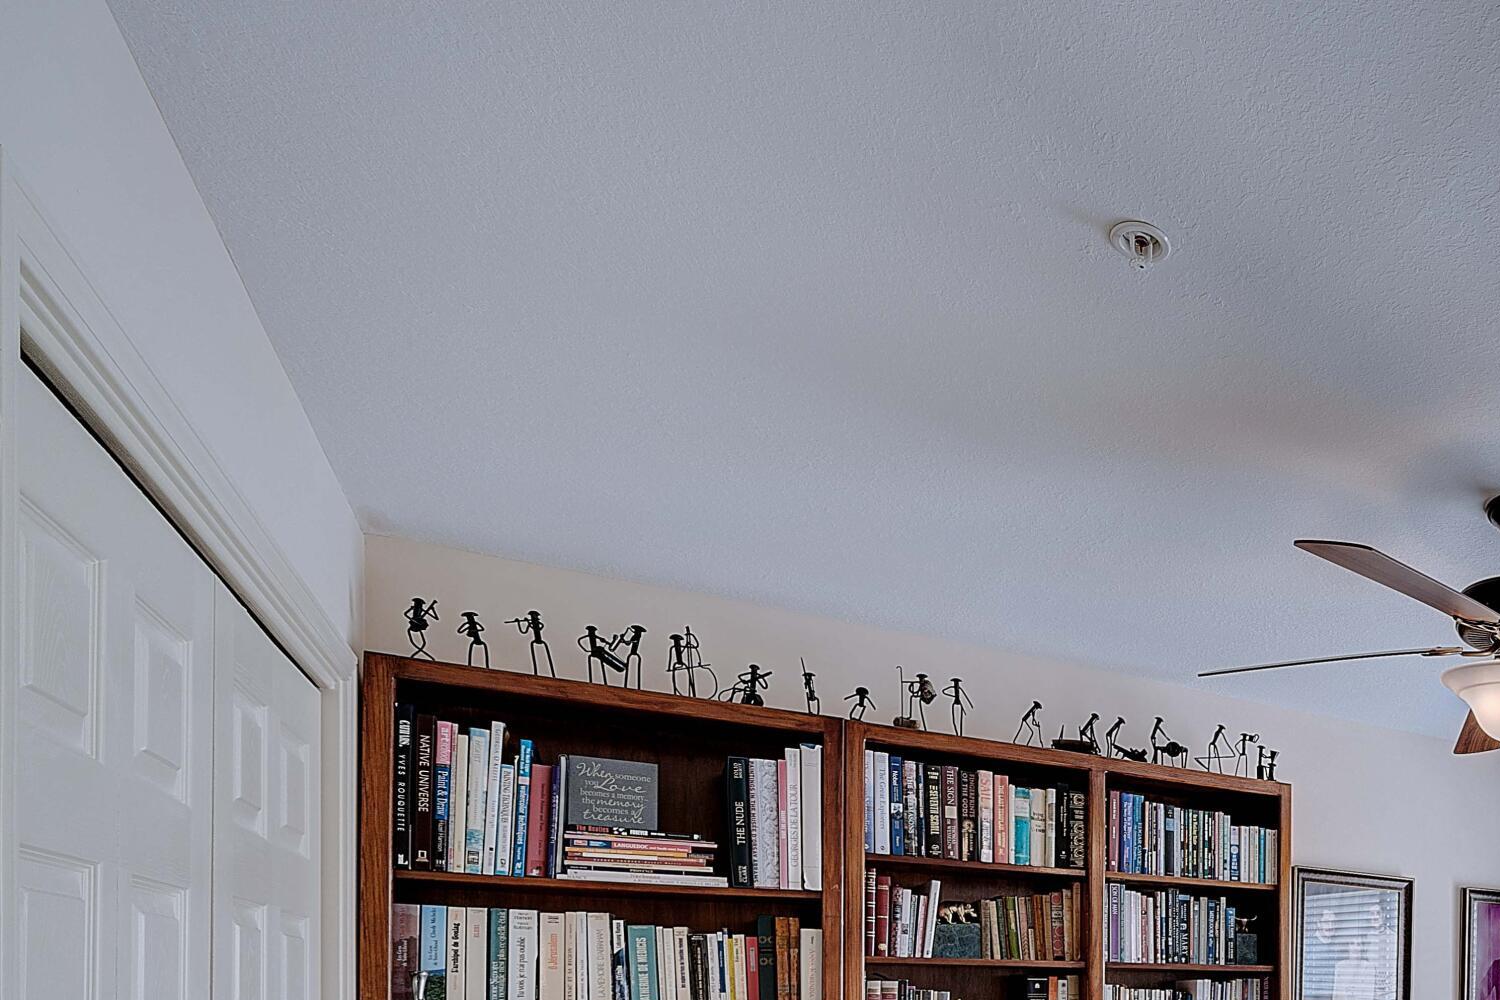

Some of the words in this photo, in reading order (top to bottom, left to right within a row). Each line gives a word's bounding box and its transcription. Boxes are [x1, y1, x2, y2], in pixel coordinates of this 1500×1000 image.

[418, 734, 430, 766] NATIVE
[437, 770, 449, 788] Paint
[576, 762, 613, 779] When
[615, 774, 651, 783] someone
[946, 769, 954, 786] THE
[962, 772, 969, 783] OF
[418, 770, 429, 812] UNIVERSE
[580, 788, 610, 798] becomes
[595, 778, 647, 793] Love
[947, 786, 955, 805] SIGN
[397, 782, 406, 831] ROUQUETTE
[436, 798, 447, 815] Draw
[582, 796, 596, 804] the
[597, 798, 647, 813] memory
[592, 806, 630, 815] becomes
[584, 810, 646, 824] treasure
[735, 802, 745, 826] NUDE
[930, 814, 940, 835] SCROLL
[736, 827, 746, 845] THE
[613, 842, 649, 850] LANGUEDOC
[638, 964, 649, 972] DE
